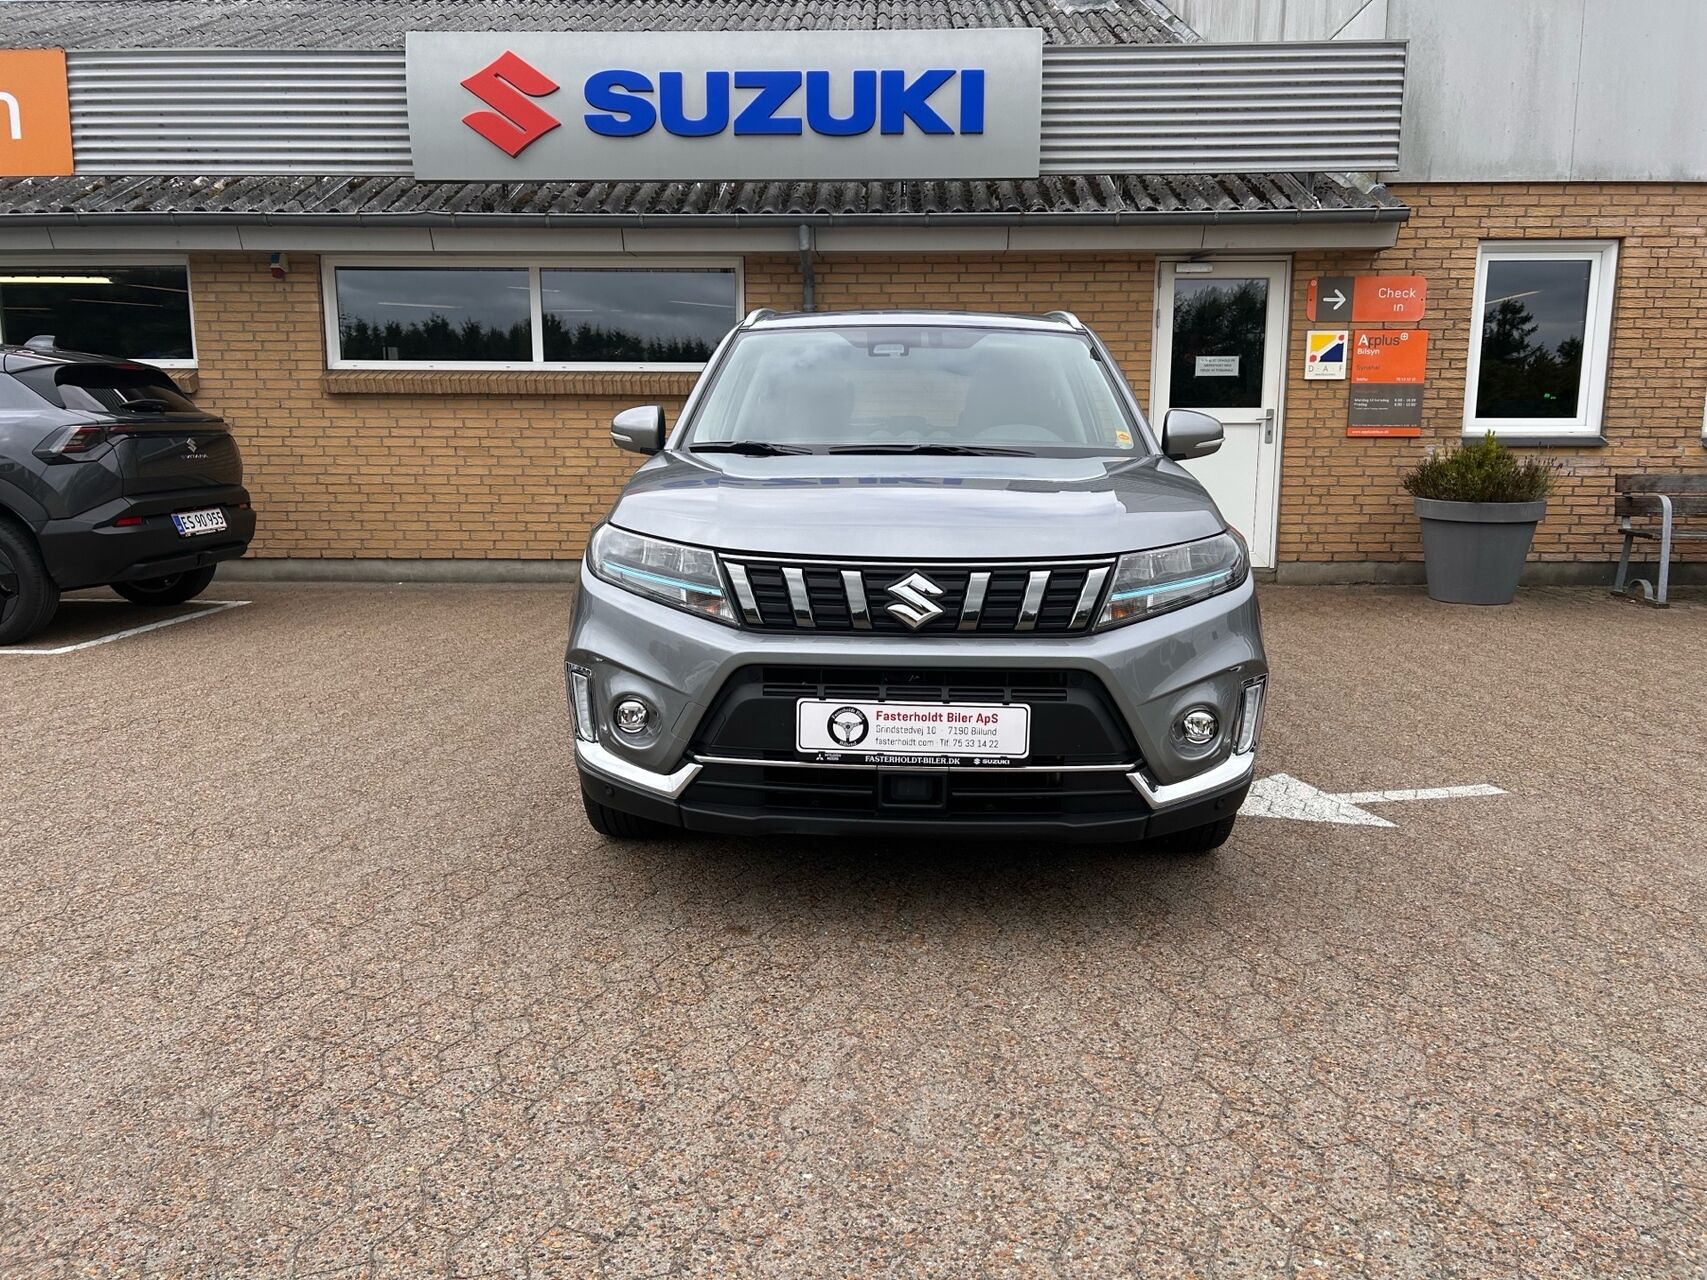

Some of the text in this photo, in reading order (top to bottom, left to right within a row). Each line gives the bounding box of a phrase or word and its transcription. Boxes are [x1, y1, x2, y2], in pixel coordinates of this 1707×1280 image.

[584, 69, 985, 138] SUZUKI
[1378, 287, 1416, 298] Check
[1393, 301, 1404, 312] in
[1357, 347, 1380, 356] Bilsyn
[180, 511, 224, 530] ES 90 955
[875, 711, 999, 726] Fasterholdt Biler ApS
[875, 724, 998, 737] Grindstedvej 10 7190 Billund
[875, 737, 934, 748] fasterholdt.com
[952, 739, 964, 748] 75
[965, 739, 975, 748] 33
[977, 740, 987, 748] 14
[988, 740, 999, 749] 22
[865, 755, 961, 765] FASTERHOLDT-BILER.DK
